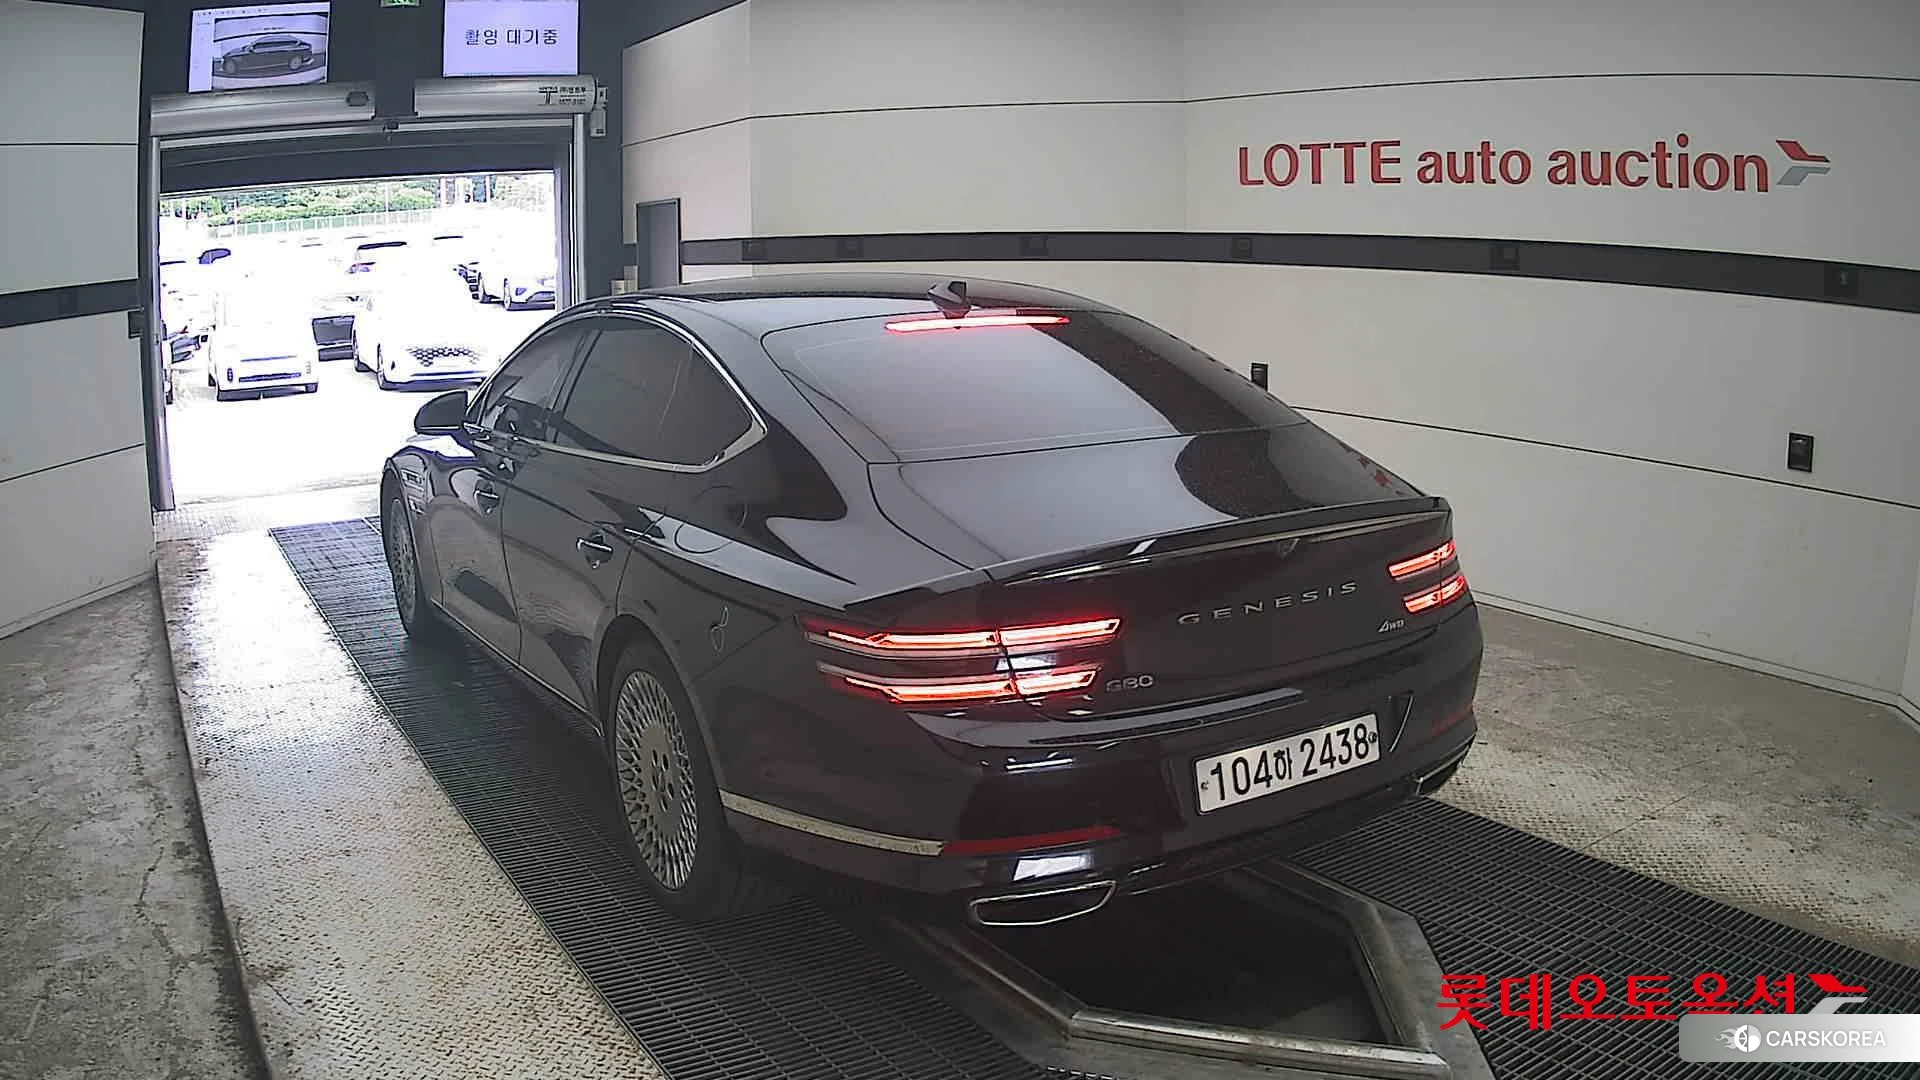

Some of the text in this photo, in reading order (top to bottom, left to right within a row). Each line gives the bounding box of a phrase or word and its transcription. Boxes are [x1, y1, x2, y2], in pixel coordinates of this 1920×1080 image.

[1238, 132, 1769, 193] LOTTE auto auction
[1177, 580, 1359, 626] GENESIS
[1105, 674, 1154, 693] G80
[1299, 722, 1369, 777] 2438
